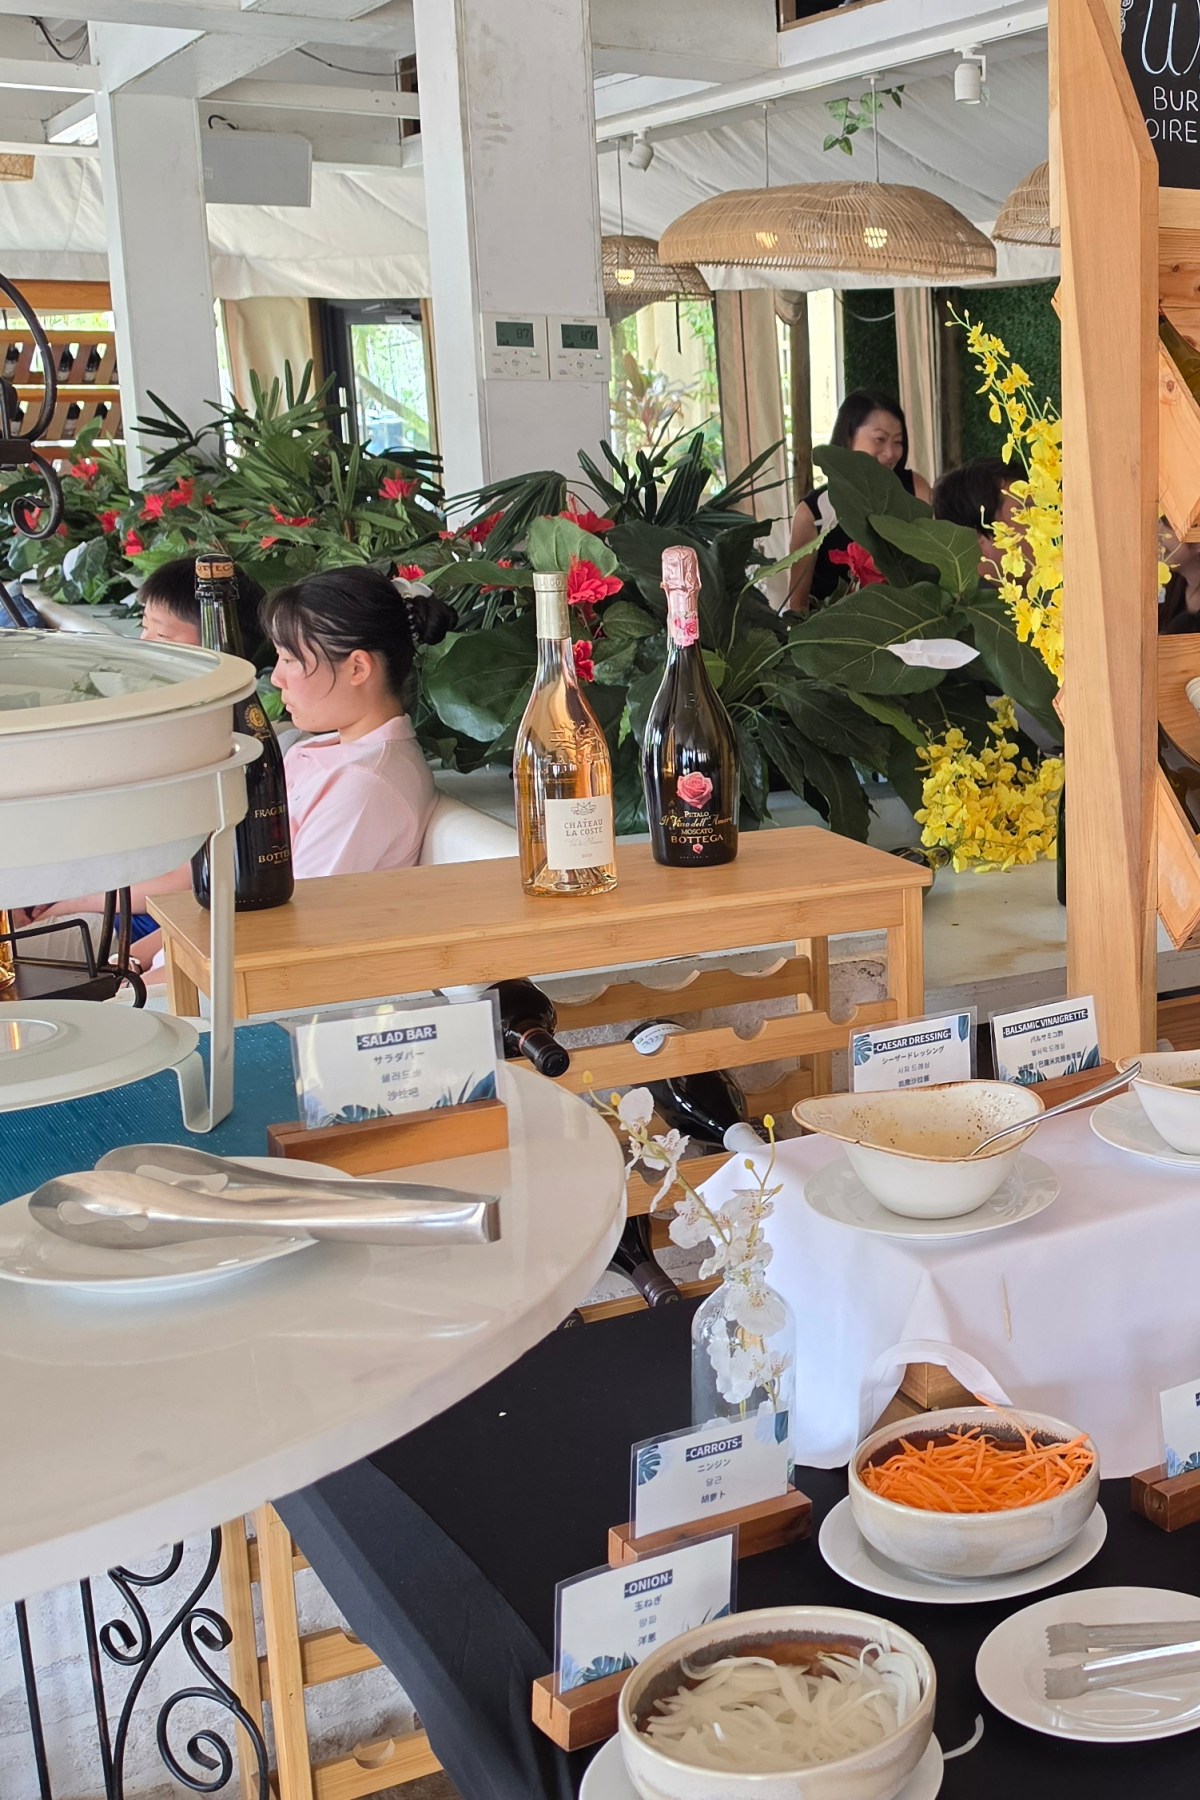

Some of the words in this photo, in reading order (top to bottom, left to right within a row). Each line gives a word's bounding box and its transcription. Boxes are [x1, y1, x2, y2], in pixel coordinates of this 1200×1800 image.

[1145, 118, 1198, 145] OIRE
[563, 818, 603, 830] CHÂTEAU
[566, 829, 578, 837] LA
[580, 827, 603, 836] COSTE
[681, 827, 714, 835] MOSCATO
[671, 834, 724, 844] BOTTEGA
[258, 850, 290, 864] BOTTE
[373, 1051, 425, 1066] サラダバー
[697, 1458, 732, 1473] ニンジン
